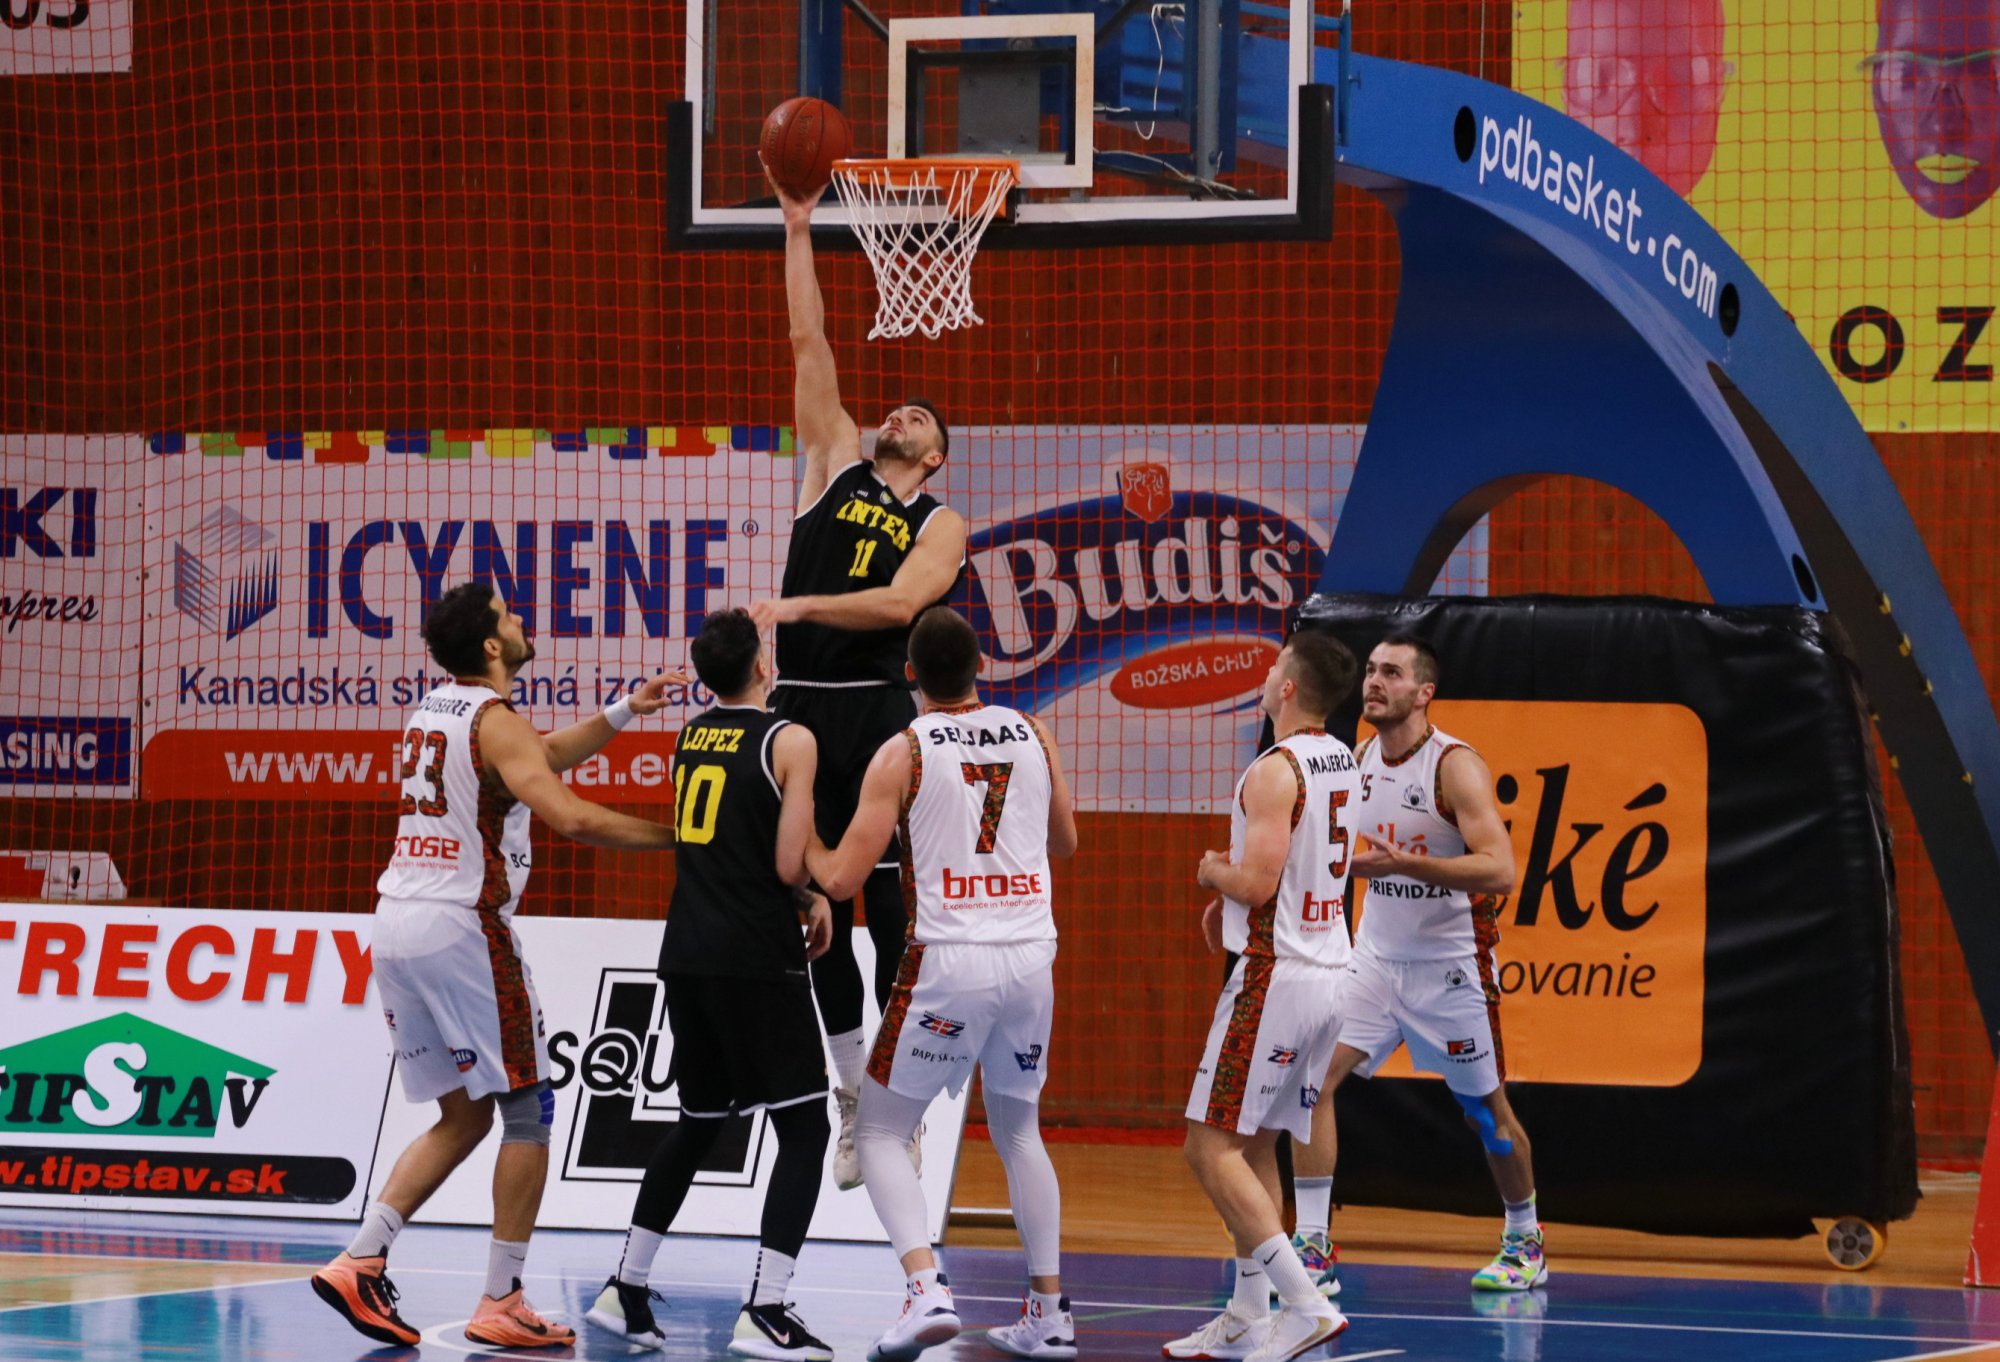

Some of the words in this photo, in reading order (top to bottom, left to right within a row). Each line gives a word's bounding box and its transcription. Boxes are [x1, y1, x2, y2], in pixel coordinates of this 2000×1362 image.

[1479, 114, 1718, 319] pdbasket.com
[1786, 305, 1996, 384] OZ
[307, 519, 727, 640] ICYNENE
[848, 538, 877, 578] 11
[970, 514, 1293, 682] Budiš
[180, 666, 377, 706] Kanadská
[392, 666, 577, 706] straná
[1131, 656, 1209, 689] BOŽSKÁ
[0, 731, 99, 771] SING
[682, 725, 745, 753] LOPEZ
[929, 723, 1029, 748] SELJAAS
[400, 727, 449, 818] 23
[1306, 749, 1357, 775] MAJERČÁ
[960, 761, 1014, 855] 7
[395, 835, 461, 861] rose
[1328, 789, 1349, 879] 5
[1495, 763, 1670, 932] ké
[942, 867, 1043, 899] brose
[1368, 878, 1453, 899] PRIEVIDZA
[0, 919, 375, 1006] RECHY
[1498, 952, 1657, 999] ovanie
[0, 1041, 270, 1129] IPSTAV
